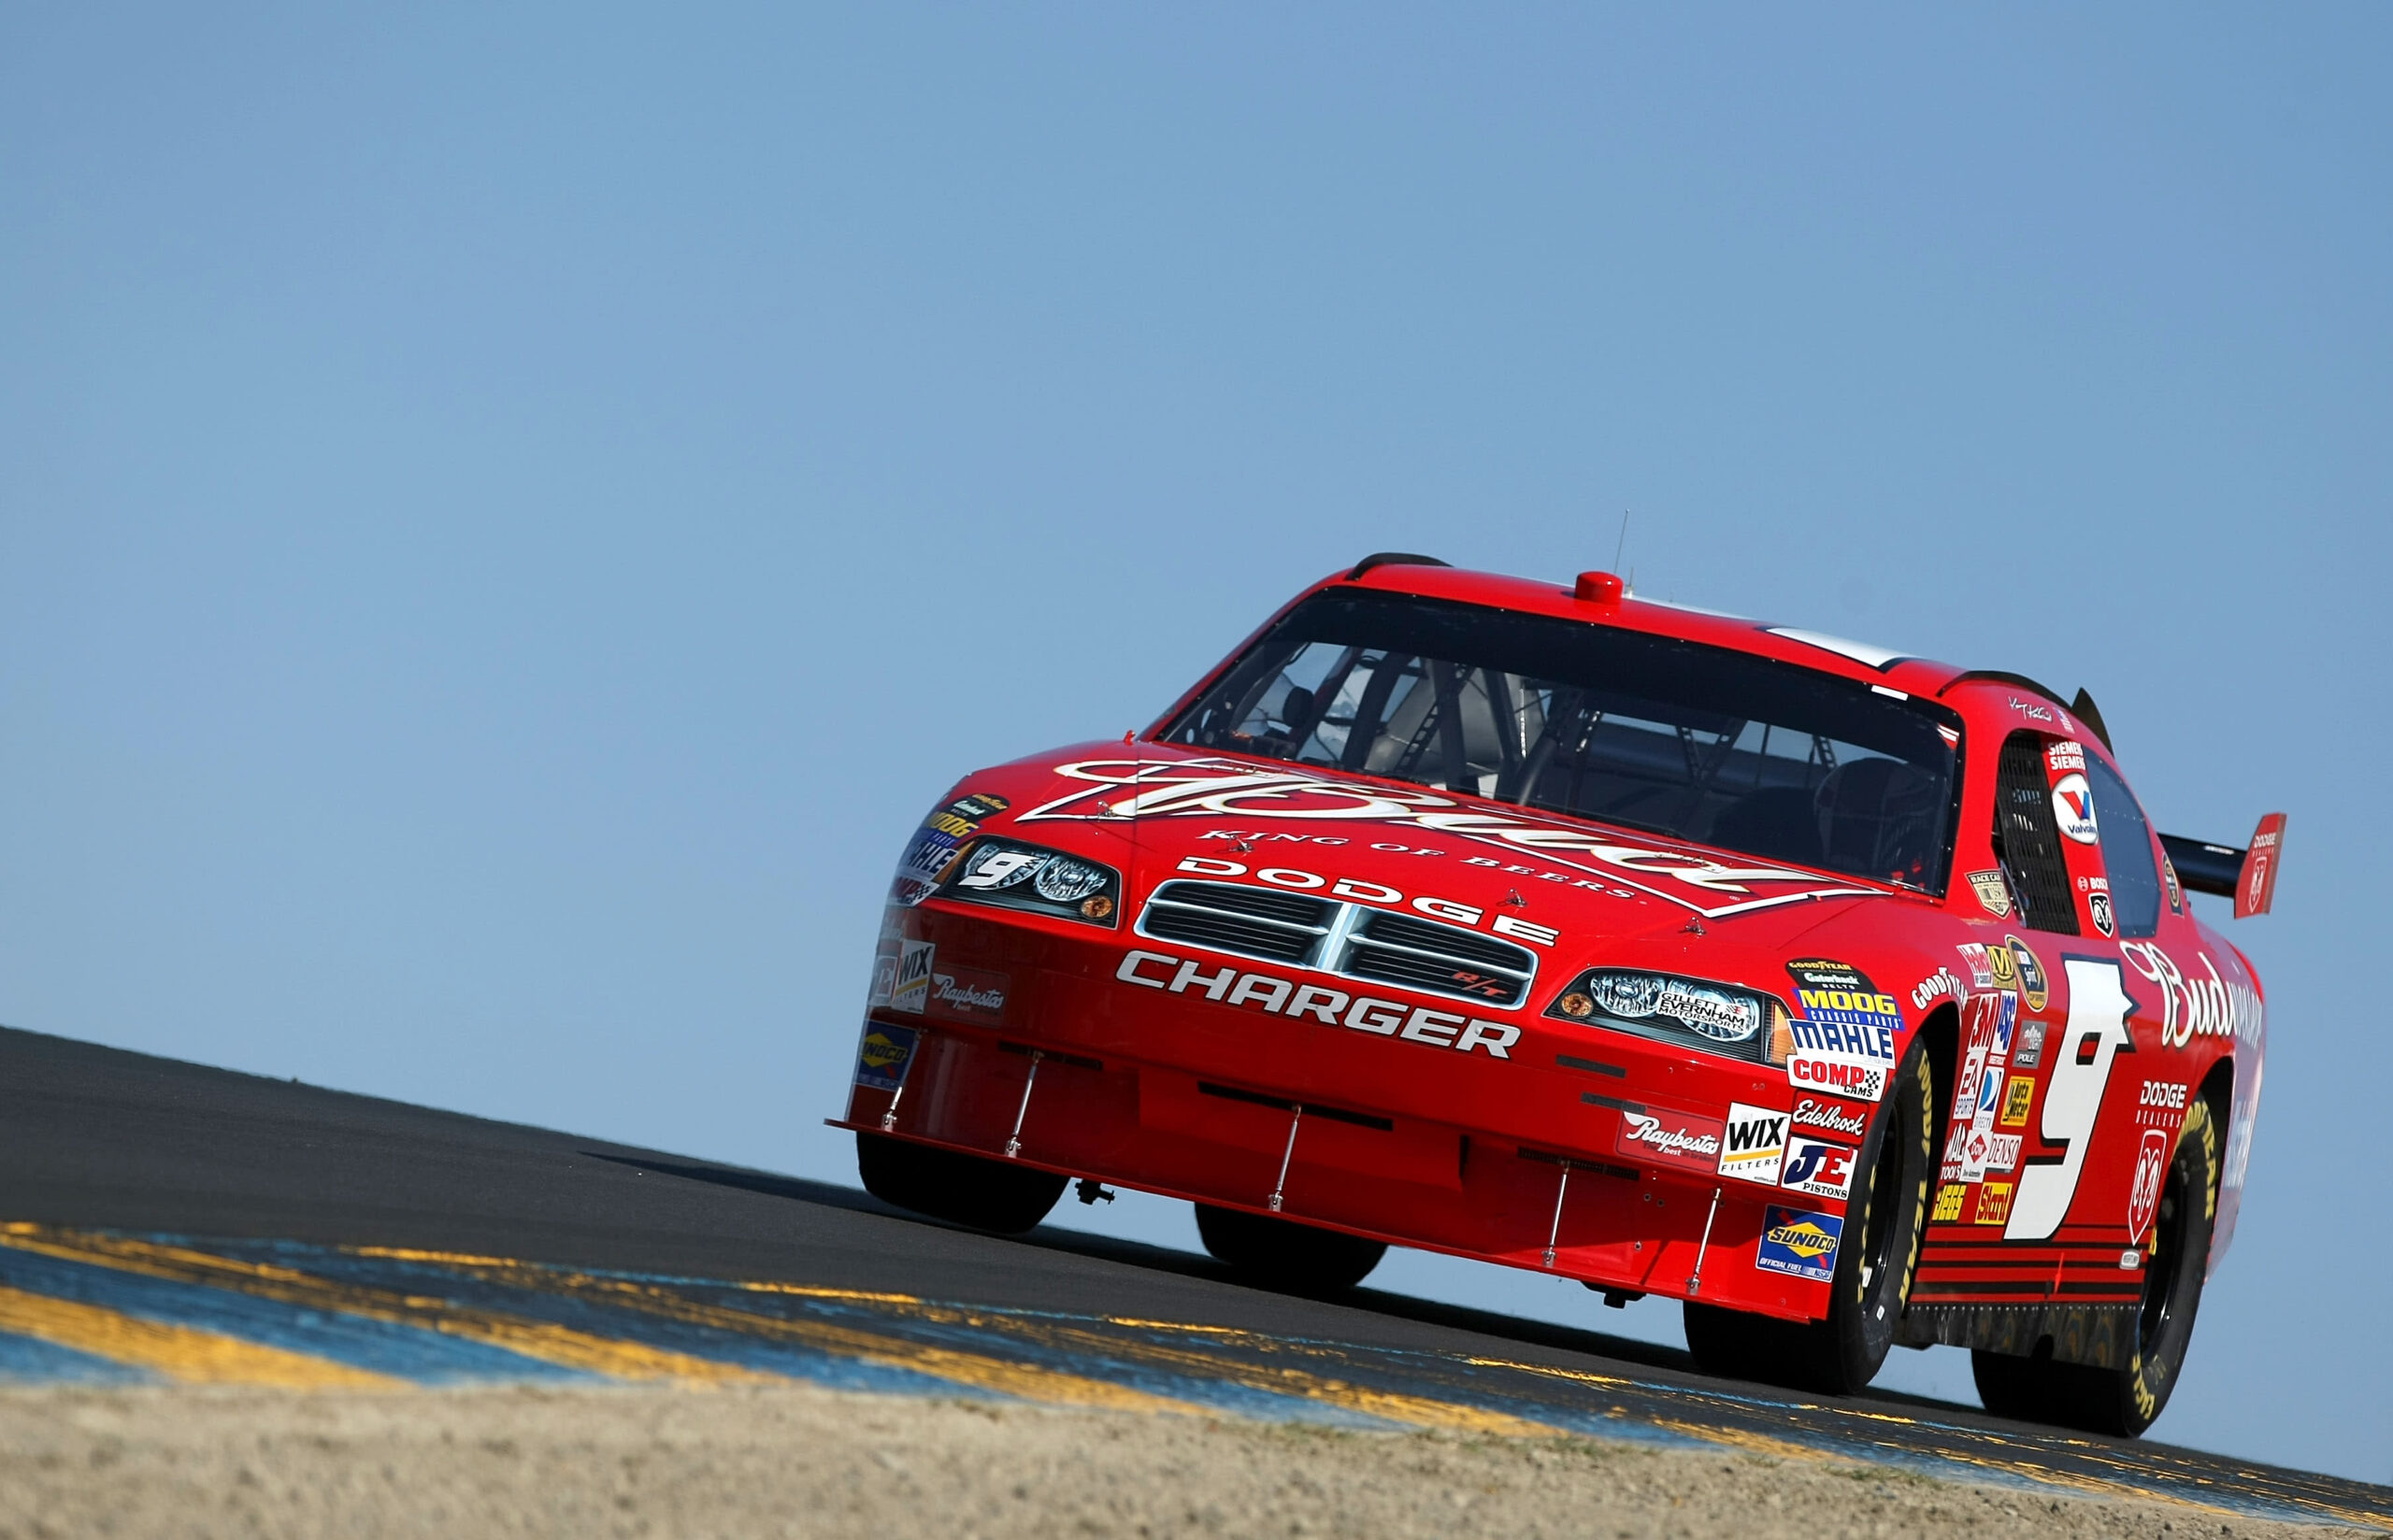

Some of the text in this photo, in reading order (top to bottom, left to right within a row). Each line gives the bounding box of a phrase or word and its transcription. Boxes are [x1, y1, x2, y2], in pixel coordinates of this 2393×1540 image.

[2254, 833, 2277, 848] DODGE
[957, 851, 1047, 888] 9
[1196, 830, 1636, 899] KING OF BEERS
[1970, 875, 1990, 884] RACE
[2089, 877, 2109, 891] BOSC
[1175, 855, 1562, 948] DODGE
[898, 947, 932, 984] WIX
[1787, 960, 1853, 971] GOODYEAR
[933, 973, 1004, 1008] Raybestos
[1451, 971, 1508, 997] R/T
[1912, 966, 1969, 1011] GOODYEAR
[1115, 948, 1523, 1060] CHARGER
[1660, 999, 1745, 1026] EVERNHAM
[1661, 992, 1720, 1010] GILLETT
[1798, 990, 1897, 1016] MOOG
[1658, 1006, 1744, 1032] MOTORSPORTS
[1810, 1010, 1899, 1029] CHASSIS PARTS
[1970, 995, 1998, 1048] 3M
[864, 1041, 906, 1062] NOCO
[1789, 1020, 1893, 1060] MAHLE
[2017, 1053, 2036, 1063] POLE
[1793, 1059, 1866, 1088] COMP
[1843, 1084, 1874, 1098] CAMS
[2003, 952, 2141, 1241] 9
[2140, 1080, 2187, 1109] DODGE
[1792, 1099, 1867, 1136] Edelbrock
[1955, 1098, 1975, 1115] SPORTS
[1624, 1111, 1720, 1156] Raybestos
[1729, 1118, 1785, 1151] WIX
[1663, 1148, 1682, 1157] best
[1721, 1157, 1780, 1173] FILTERS
[1987, 1138, 2020, 1165] DENSO
[1784, 1145, 1854, 1187] JE
[1802, 1182, 1848, 1199] PISTONS
[1932, 1184, 1968, 1221] JEGS
[1770, 1226, 1835, 1252] SUNOCO
[1759, 1257, 1802, 1272] OFFICIAL FUEL
